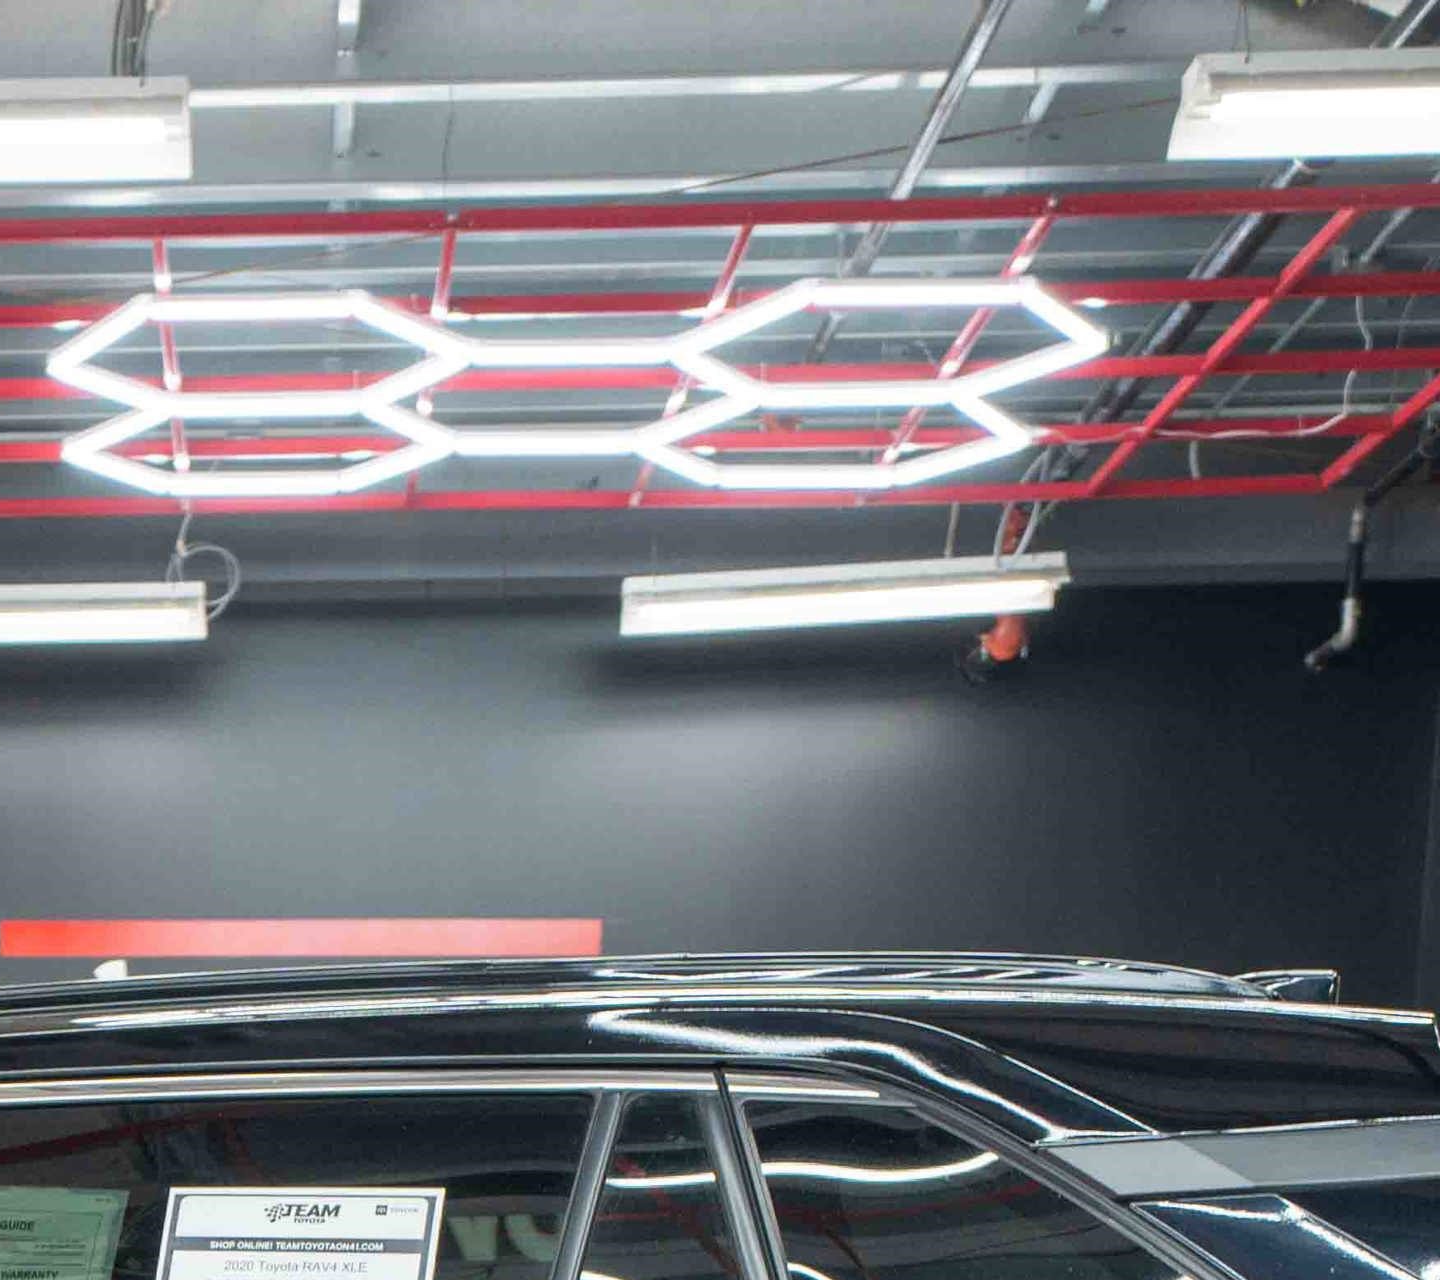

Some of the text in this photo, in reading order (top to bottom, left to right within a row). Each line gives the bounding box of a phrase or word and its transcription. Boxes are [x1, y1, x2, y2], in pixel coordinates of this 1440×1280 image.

[282, 1203, 342, 1217] TEAM
[0, 1220, 35, 1232] GUIDE
[210, 1240, 235, 1250] SHOP
[224, 1260, 368, 1274] 2020 Toyota RAV4 XLE
[0, 1269, 59, 1280] WARRANTY
